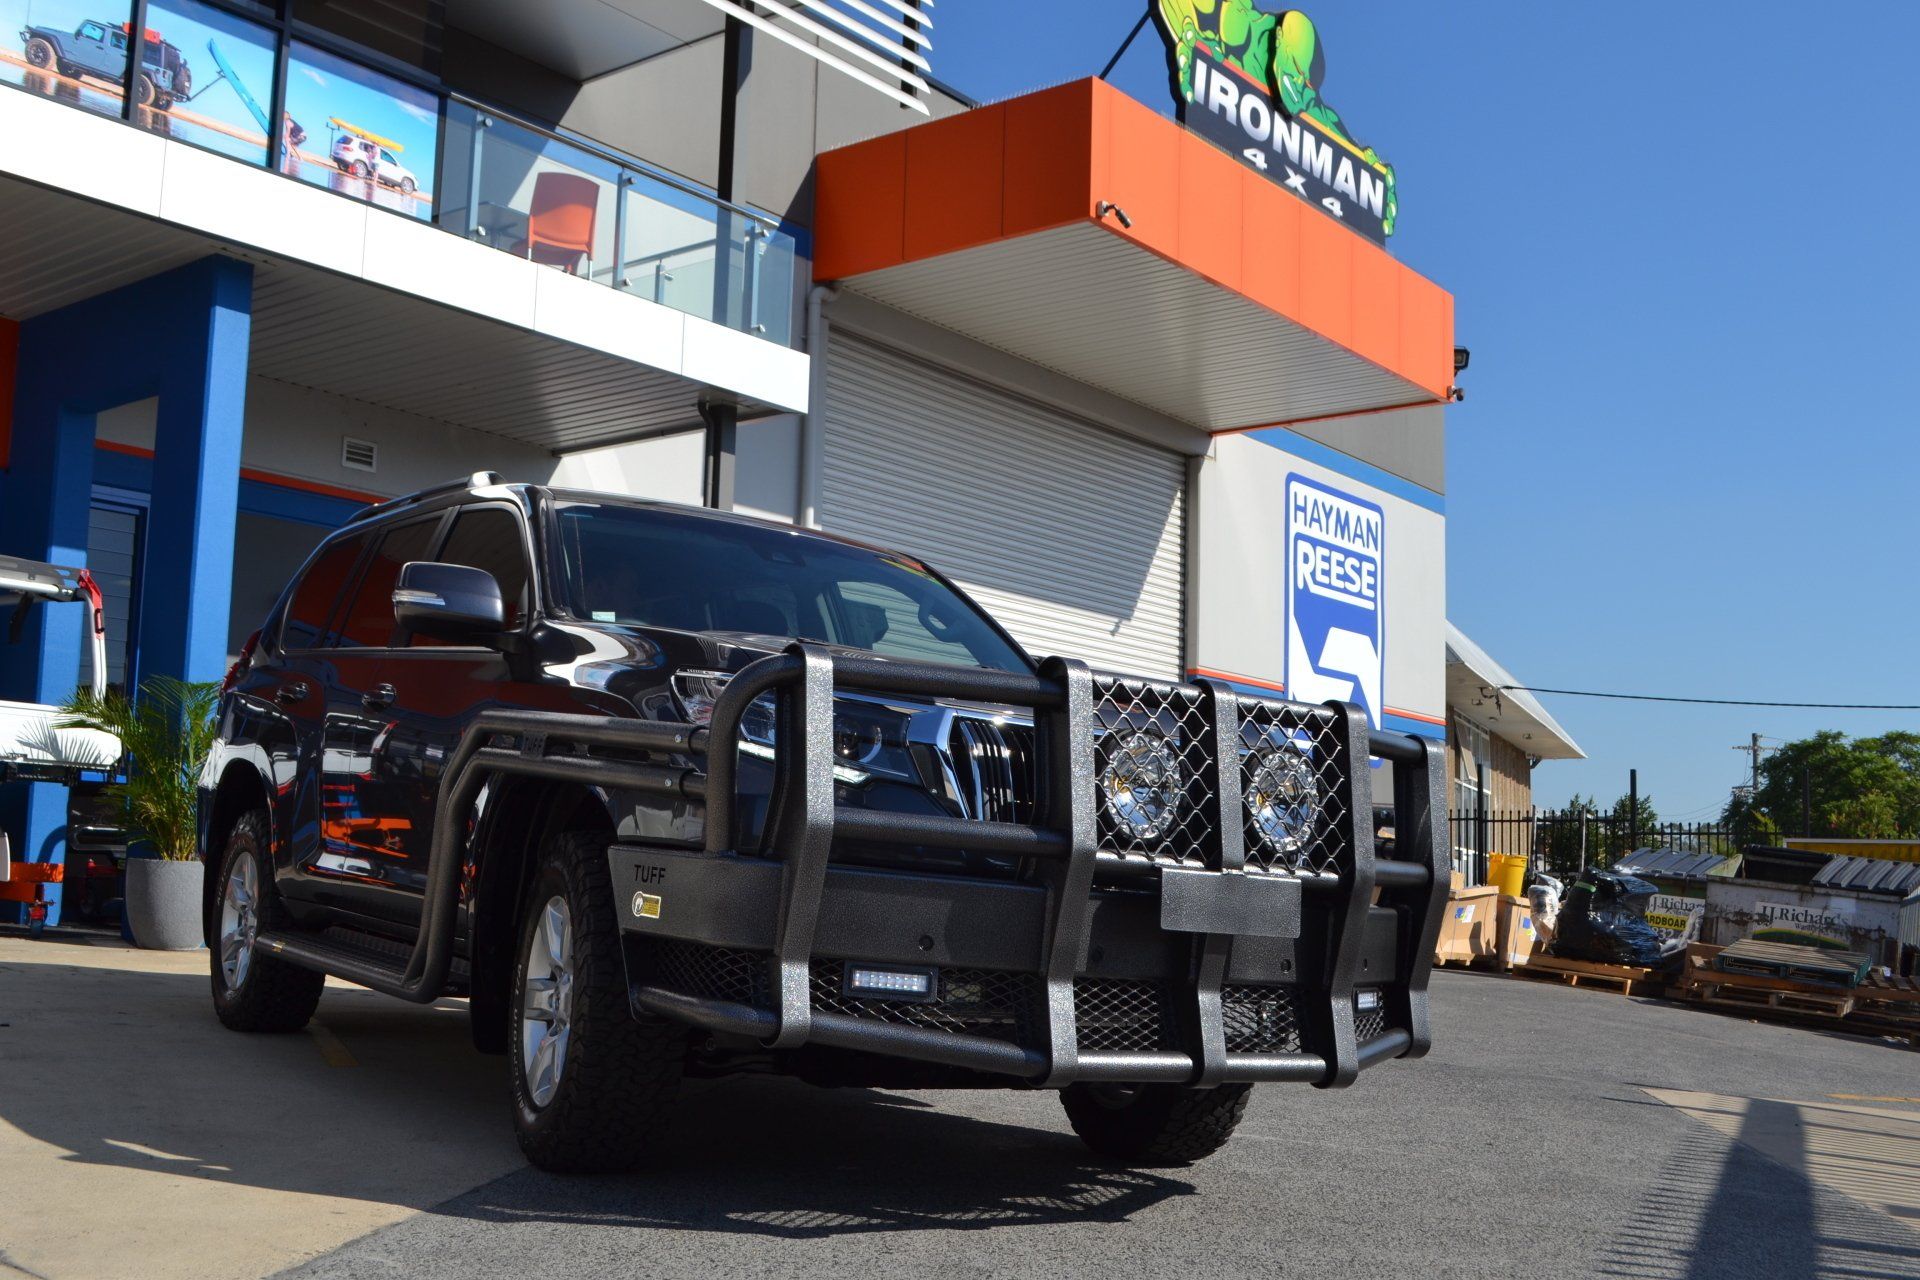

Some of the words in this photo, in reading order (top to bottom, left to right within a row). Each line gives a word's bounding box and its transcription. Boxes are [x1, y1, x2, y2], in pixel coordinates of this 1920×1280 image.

[1194, 58, 1384, 219] IRONMAN
[1243, 148, 1268, 170] 4
[1322, 196, 1343, 218] 4
[1294, 491, 1378, 552] HAYMAN
[1297, 539, 1376, 598] REESE
[634, 864, 666, 884] TUFF
